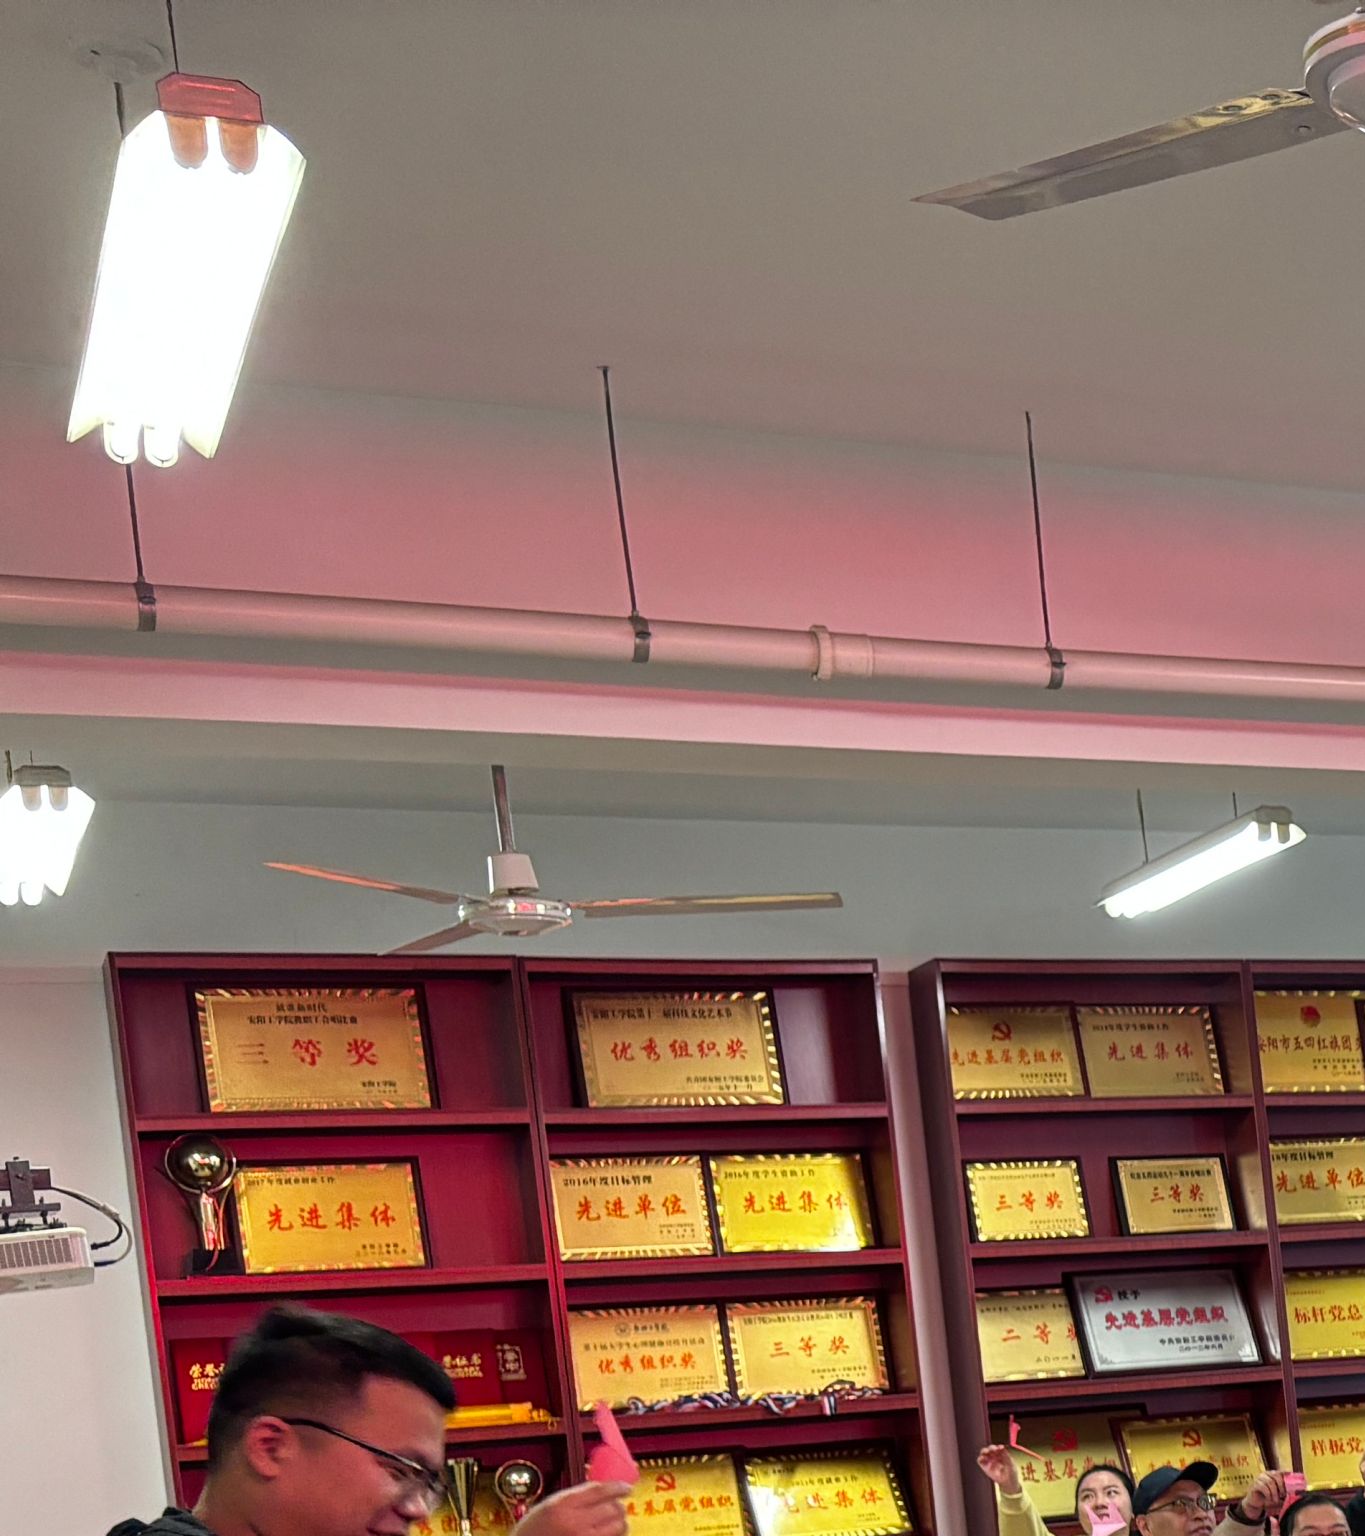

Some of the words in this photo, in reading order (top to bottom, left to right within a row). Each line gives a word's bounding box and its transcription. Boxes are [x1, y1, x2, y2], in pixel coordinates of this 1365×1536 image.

[236, 1038, 379, 1067] 三等奖
[611, 1036, 748, 1062] 优秀组织奖
[952, 1047, 1064, 1066] 先进基层党组织
[1108, 1041, 1193, 1061] 先进集体
[744, 1190, 848, 1214] 先进集体
[996, 1190, 1064, 1213] 三等奖
[1150, 1183, 1205, 1204] 三等奖
[267, 1202, 396, 1232] 先进集体
[577, 1194, 687, 1222] 先进单位
[1105, 1305, 1229, 1331] 先进基层党组织
[769, 1335, 850, 1358] 三等奖
[598, 1351, 696, 1375] 优秀组织奖
